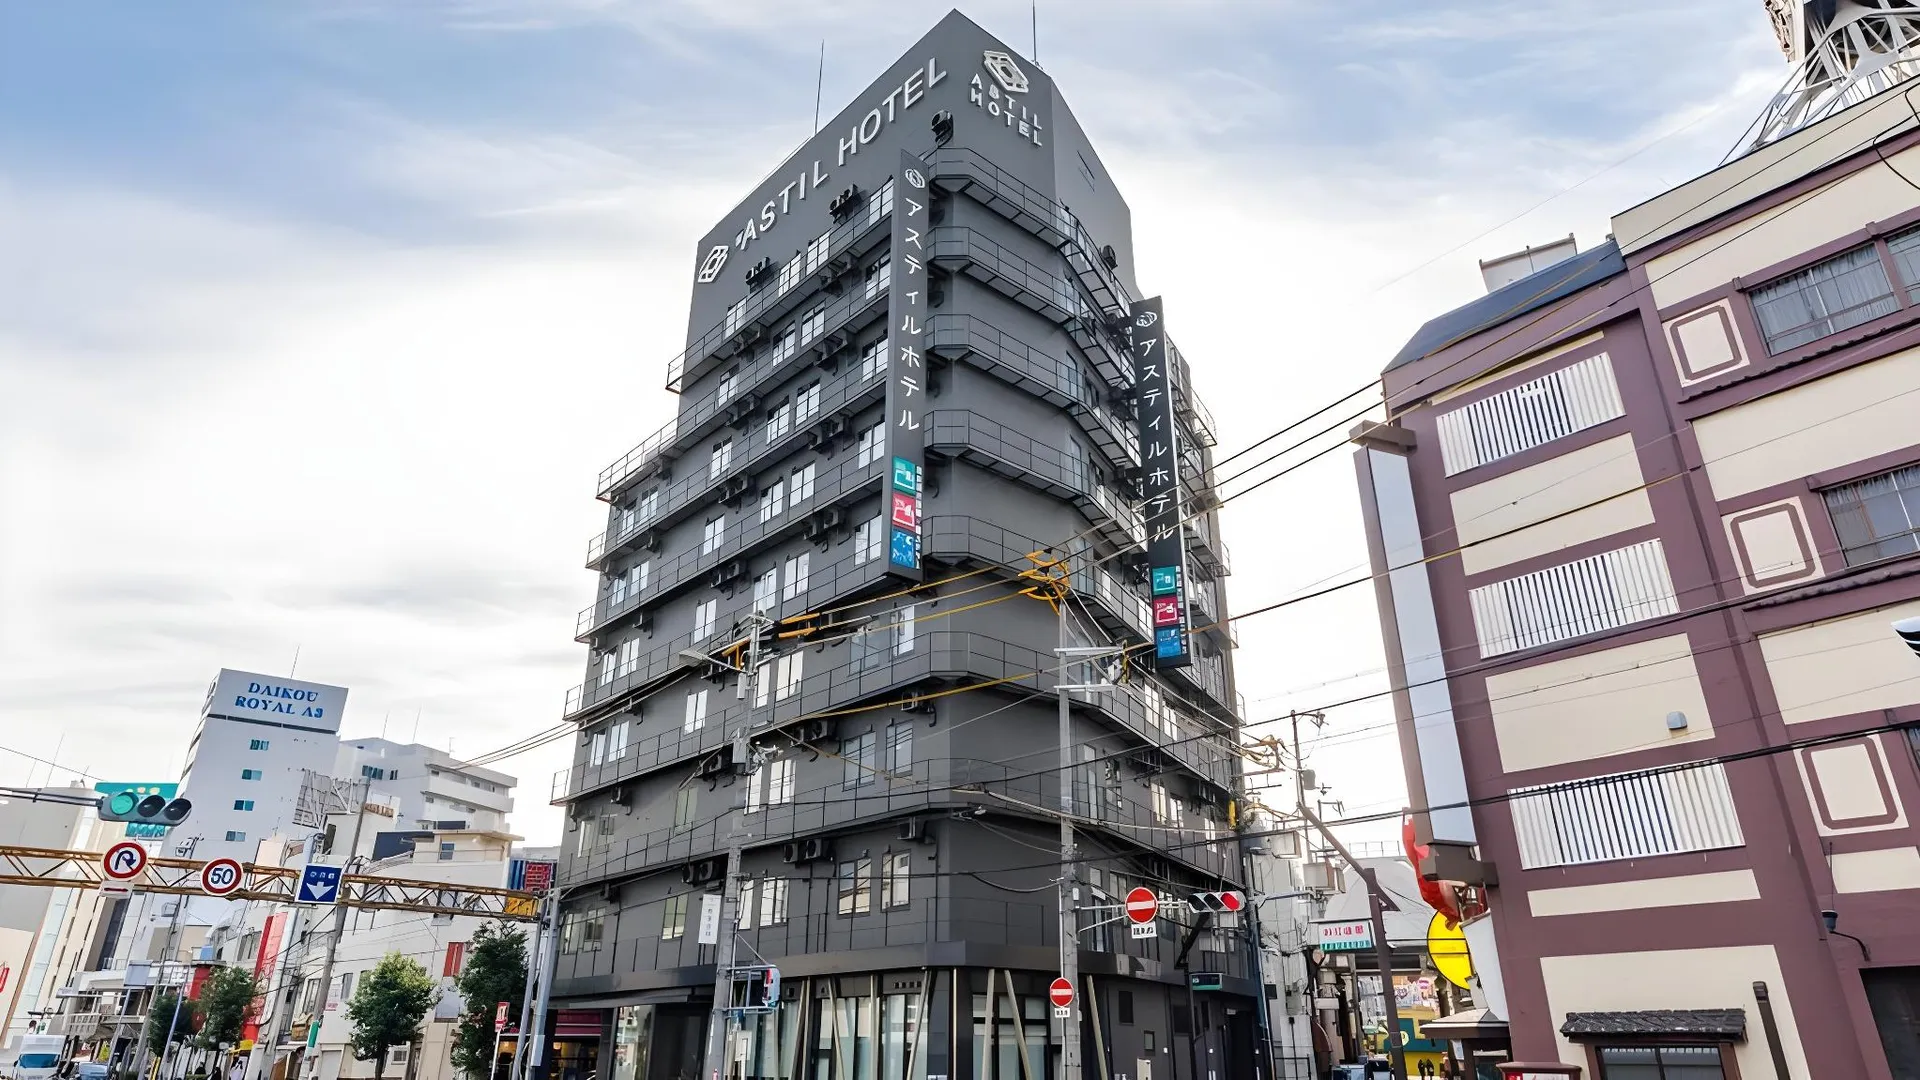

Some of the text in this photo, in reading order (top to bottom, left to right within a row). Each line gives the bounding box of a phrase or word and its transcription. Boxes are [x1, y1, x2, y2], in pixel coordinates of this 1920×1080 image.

[969, 88, 1043, 148] HOTEL
[738, 56, 948, 251] ASTIL HOTEL
[900, 197, 924, 432] アスティルホテル
[1139, 337, 1175, 543] アスティルホテル
[234, 695, 296, 715] ROYAL
[248, 682, 319, 703] DAIKOU
[210, 867, 234, 885] 50
